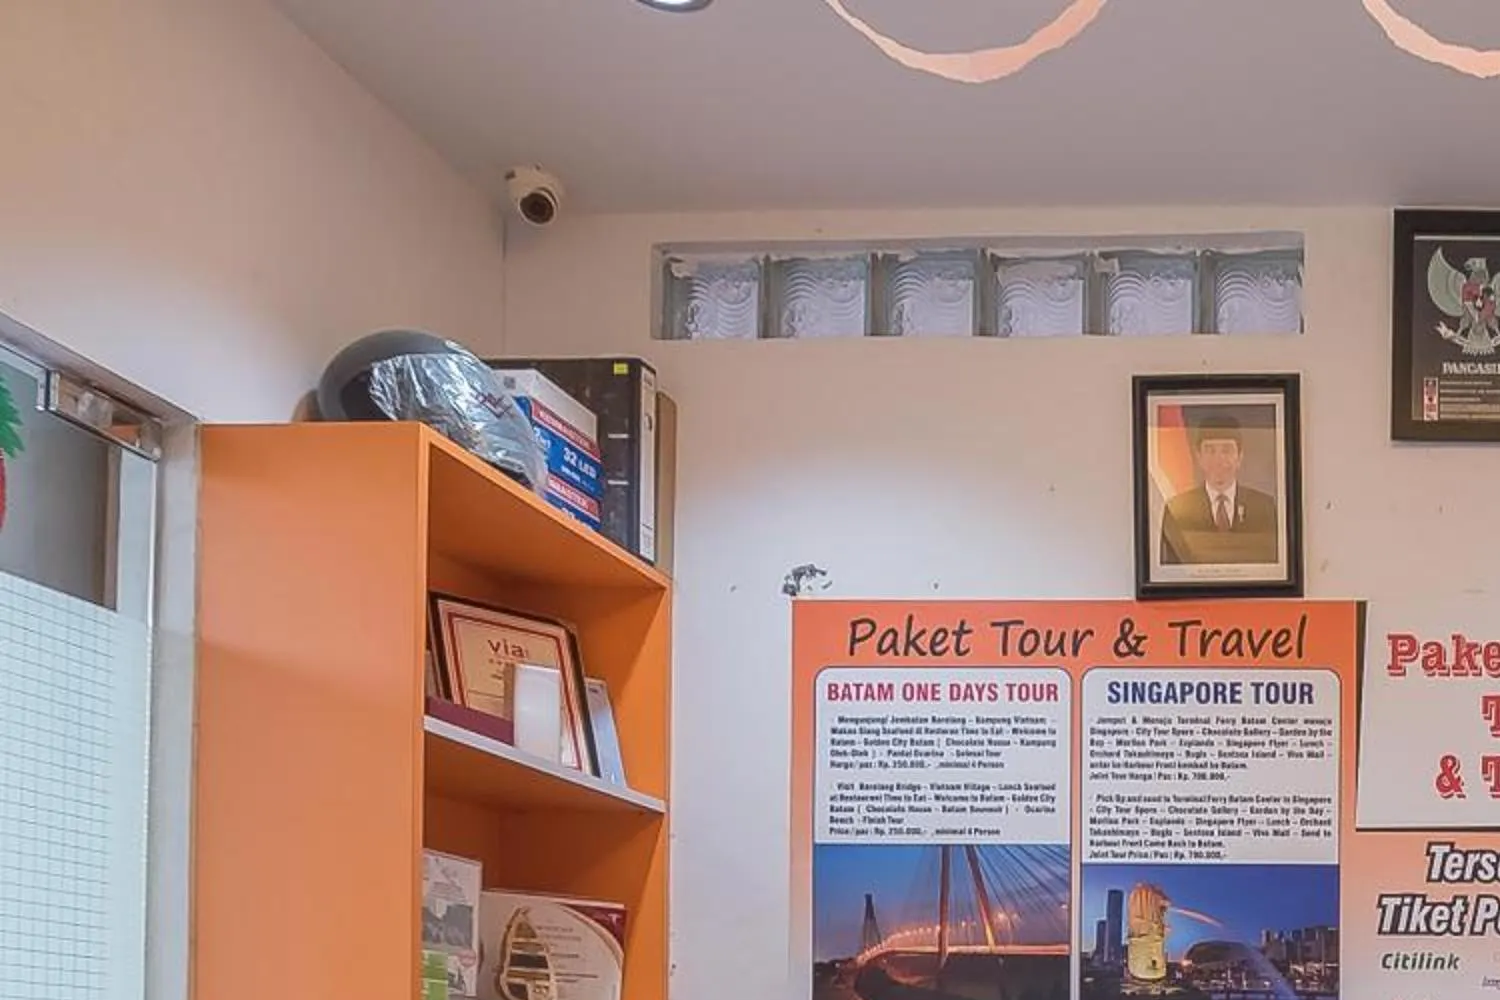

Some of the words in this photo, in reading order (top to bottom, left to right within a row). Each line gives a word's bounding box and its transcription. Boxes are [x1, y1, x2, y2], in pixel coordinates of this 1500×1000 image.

[848, 614, 974, 657] Paket
[990, 618, 1094, 658] Tour
[1113, 618, 1147, 657] &
[1168, 614, 1309, 660] Travel
[827, 683, 894, 702] BATAM
[902, 683, 941, 702] ONE
[949, 683, 999, 702] DAYS
[1005, 683, 1060, 702] TOUR
[1107, 681, 1243, 705] SINGAPORE
[1250, 682, 1315, 705] TOUR
[1434, 755, 1466, 799] &
[1378, 894, 1469, 936] Tiket
[1381, 951, 1460, 971] Citilink
